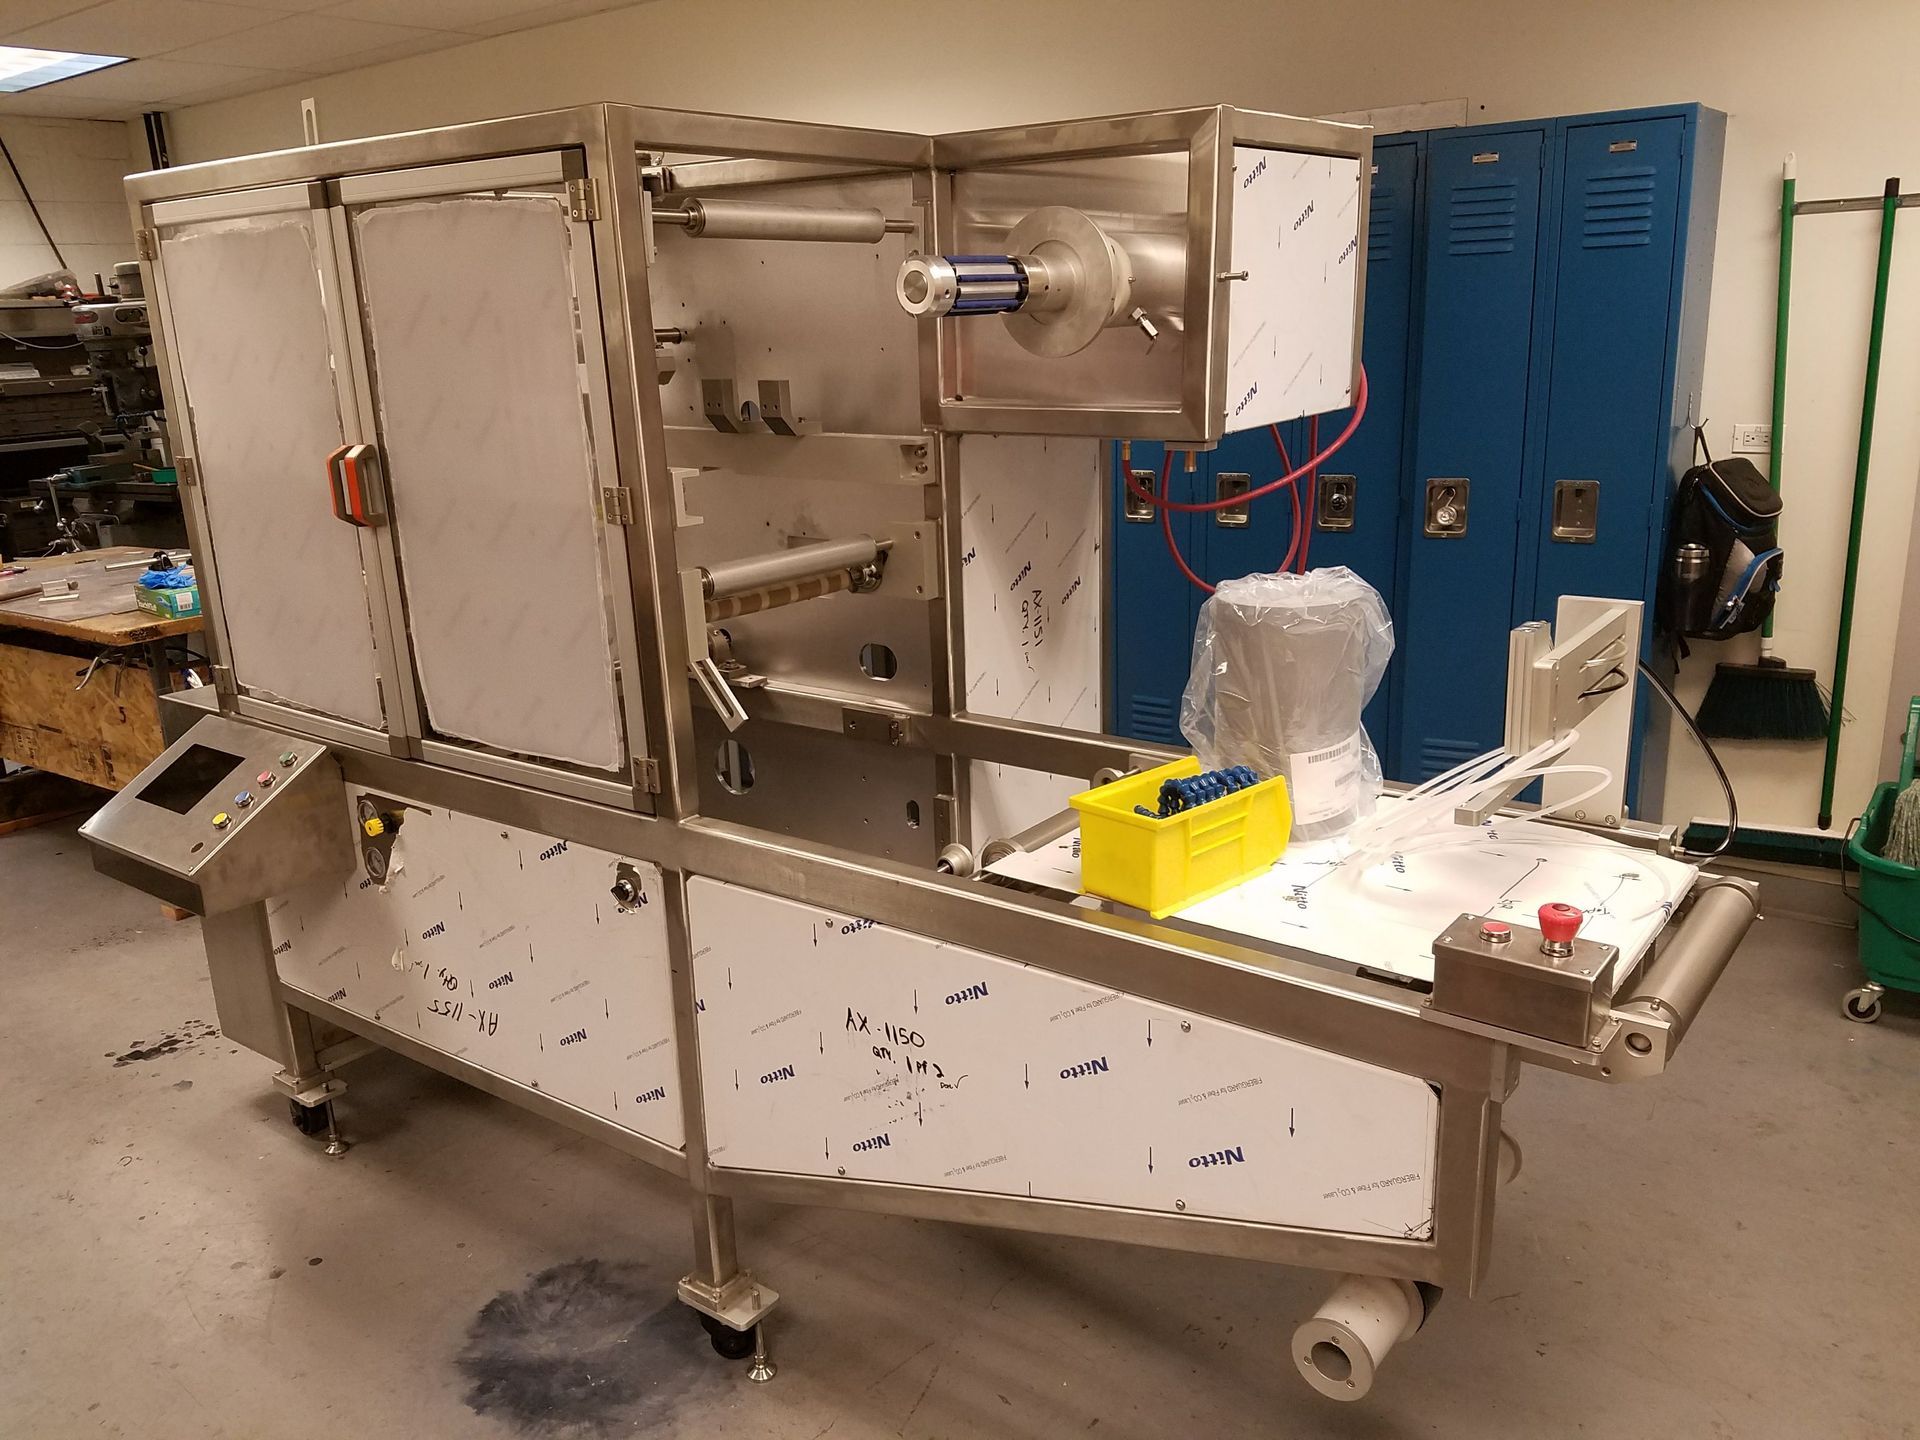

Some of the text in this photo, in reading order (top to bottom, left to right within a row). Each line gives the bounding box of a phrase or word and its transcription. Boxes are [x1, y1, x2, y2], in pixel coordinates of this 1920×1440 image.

[1243, 156, 1267, 188] Nitto
[1293, 200, 1314, 231] Nitto
[1338, 235, 1358, 264] Nitto
[1235, 382, 1258, 416] Nitto
[1010, 560, 1032, 592] Nitto
[1061, 576, 1081, 605] Nitto
[1031, 588, 1043, 647] AX-1151
[539, 840, 568, 861] Nitto
[421, 921, 446, 941] Nitto
[274, 939, 292, 956] Nitto
[488, 971, 514, 990] Nitto
[328, 988, 347, 1003] Nitto
[945, 982, 989, 1006] Nitto
[560, 1028, 588, 1046] Nitto
[760, 1064, 796, 1085] Nitto
[1059, 1056, 1110, 1080] Nitto
[635, 1086, 666, 1103] Nitto
[852, 1133, 892, 1152] Nitto
[1188, 1146, 1245, 1168] Nitto
